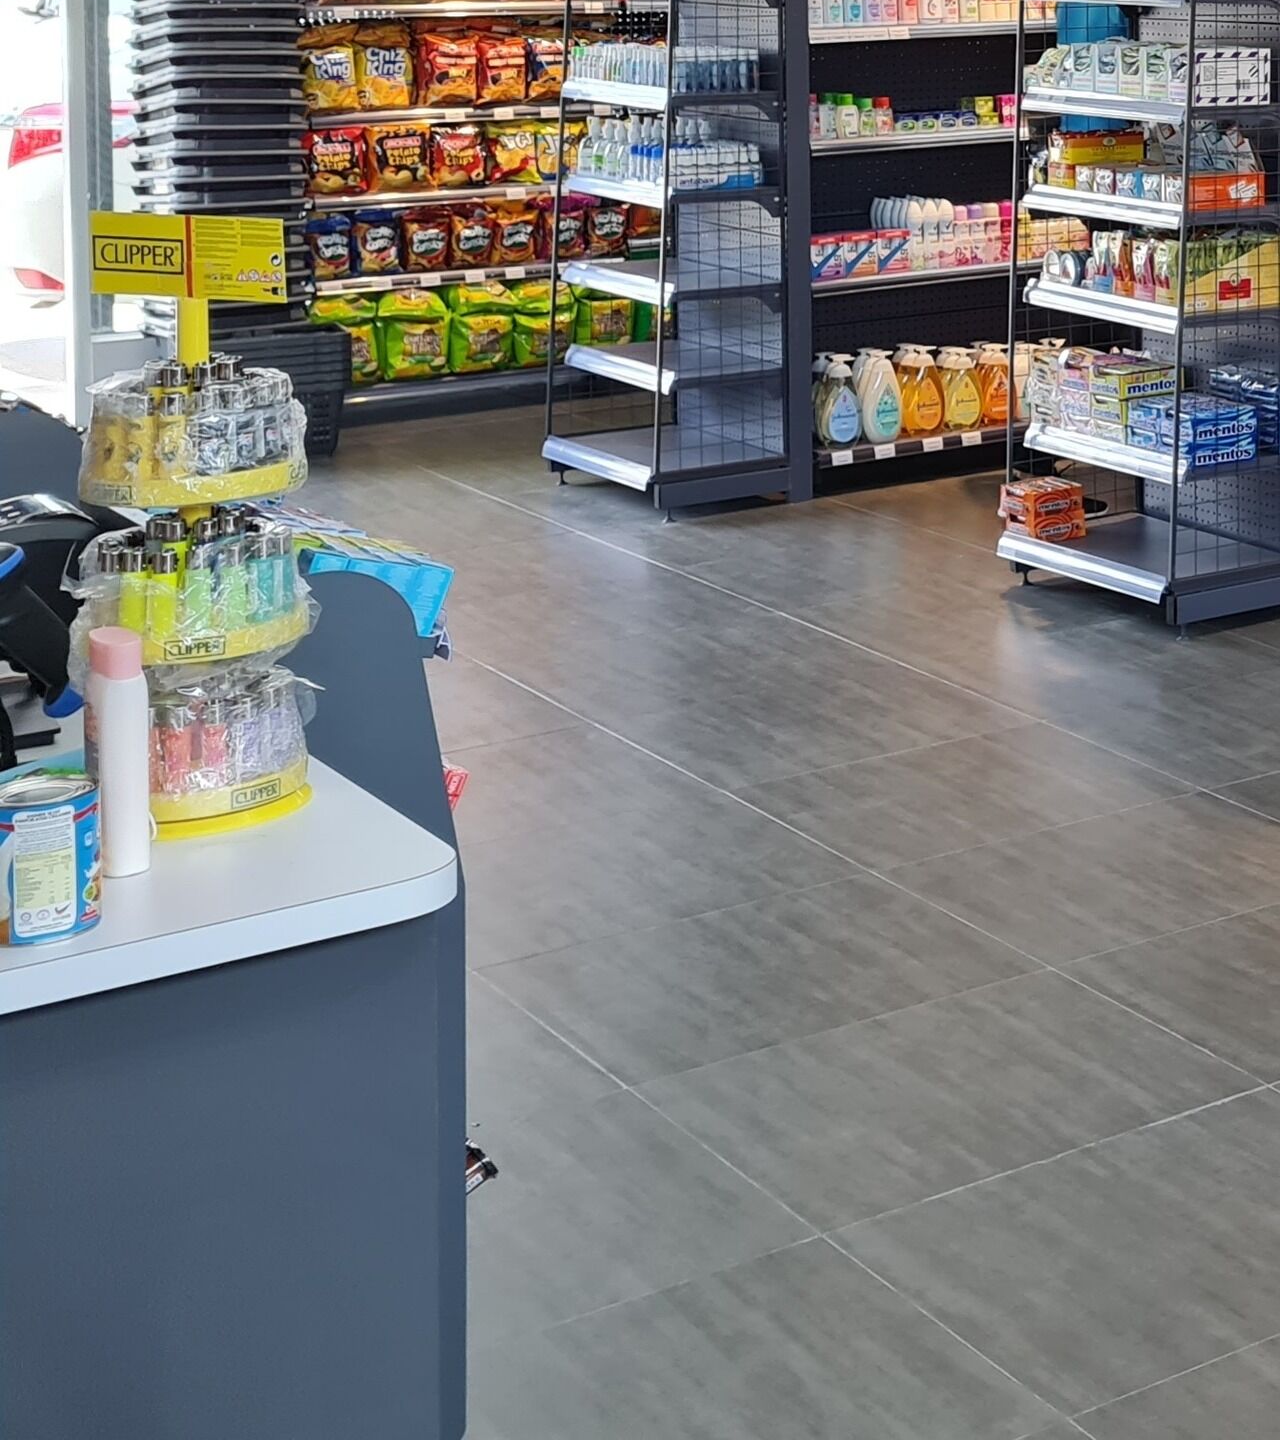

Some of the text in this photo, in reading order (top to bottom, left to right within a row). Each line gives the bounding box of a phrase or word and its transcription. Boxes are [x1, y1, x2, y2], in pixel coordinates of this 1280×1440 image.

[316, 61, 350, 80] King
[366, 60, 405, 77] King
[100, 243, 175, 266] CLIPPER
[1198, 421, 1253, 439] mentos
[1197, 448, 1251, 466] mentos
[169, 639, 223, 658] CLIPPER
[236, 782, 280, 809] CLIPPER
